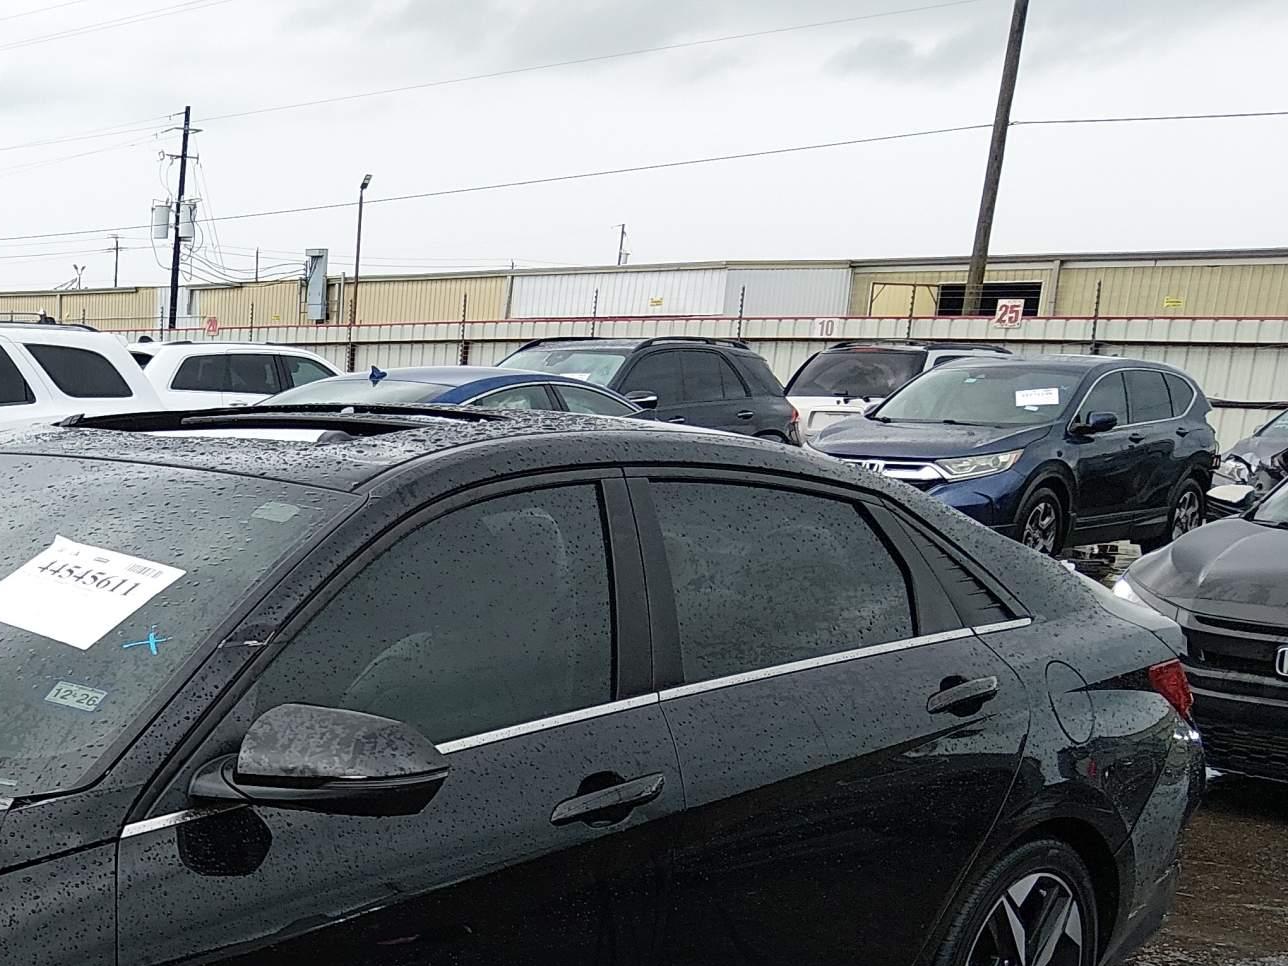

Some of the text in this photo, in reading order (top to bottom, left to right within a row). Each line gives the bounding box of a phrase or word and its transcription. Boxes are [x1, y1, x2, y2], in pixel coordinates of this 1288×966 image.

[997, 303, 1021, 324] 25
[818, 319, 835, 337] 10
[38, 560, 141, 596] 44545611
